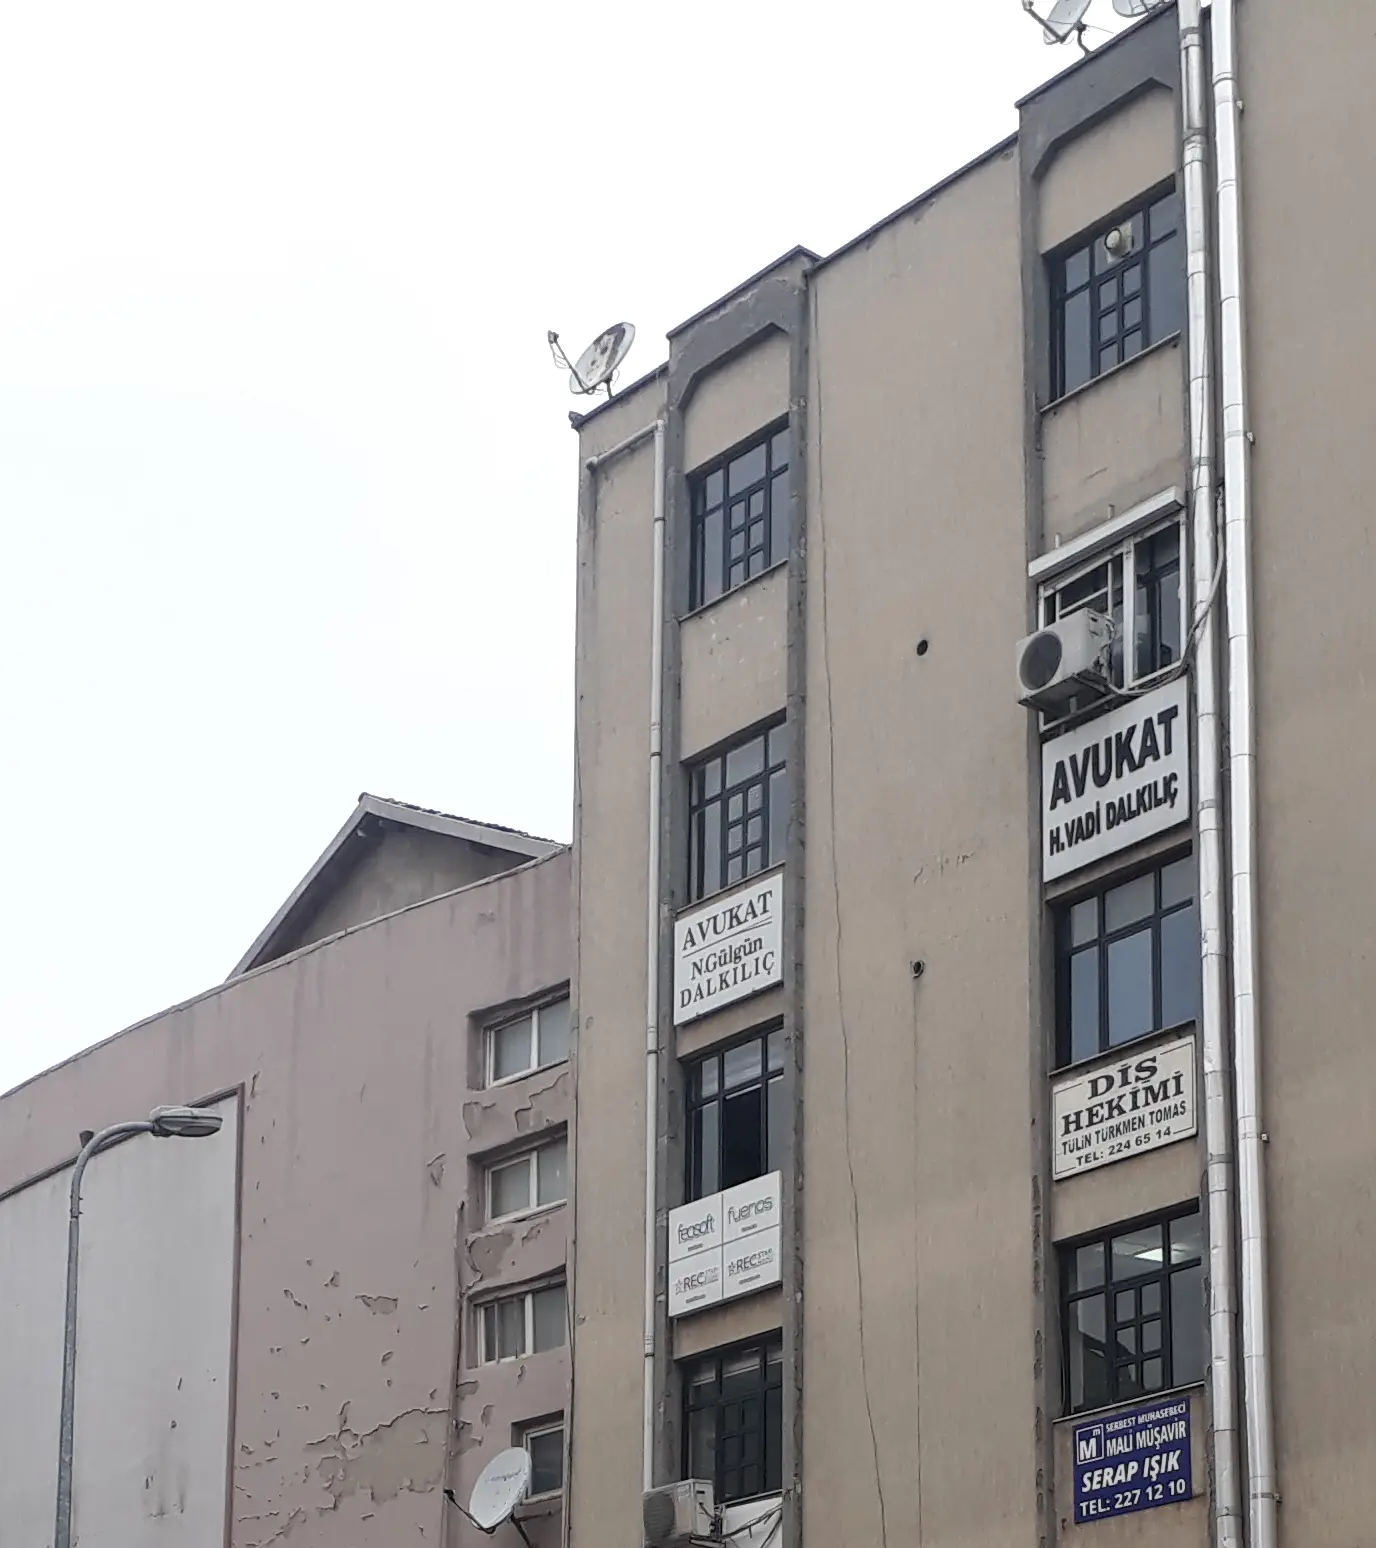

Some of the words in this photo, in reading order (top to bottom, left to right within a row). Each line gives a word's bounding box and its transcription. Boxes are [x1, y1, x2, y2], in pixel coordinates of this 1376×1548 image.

[1049, 704, 1179, 811] AVUKAT
[1049, 800, 1101, 857] H.VADİ
[1105, 771, 1179, 831] DALKILIÇ
[681, 889, 774, 952] AVUKAT
[679, 950, 775, 1009] DALKILIÇ
[1060, 1070, 1185, 1138] HEKİMİ
[1087, 1055, 1159, 1101] DİŞ
[1061, 1132, 1092, 1156] TÜLİN
[1094, 1114, 1146, 1145] TÜRKMEN
[1148, 1099, 1187, 1125] TOMAS
[1075, 1150, 1105, 1167] TEL:
[1107, 1138, 1132, 1157] 224
[1134, 1132, 1151, 1147] 65
[1155, 1125, 1172, 1140] 14
[1106, 1429, 1134, 1458] MALİ
[1136, 1417, 1187, 1450] MÜŞAVİR
[1079, 1499, 1111, 1517] TEL:
[1113, 1488, 1142, 1510] 227
[1145, 1483, 1164, 1501] 12
[1167, 1478, 1186, 1496] 10
[1081, 1460, 1139, 1493] SERAP
[1142, 1449, 1182, 1482] IŞIK
